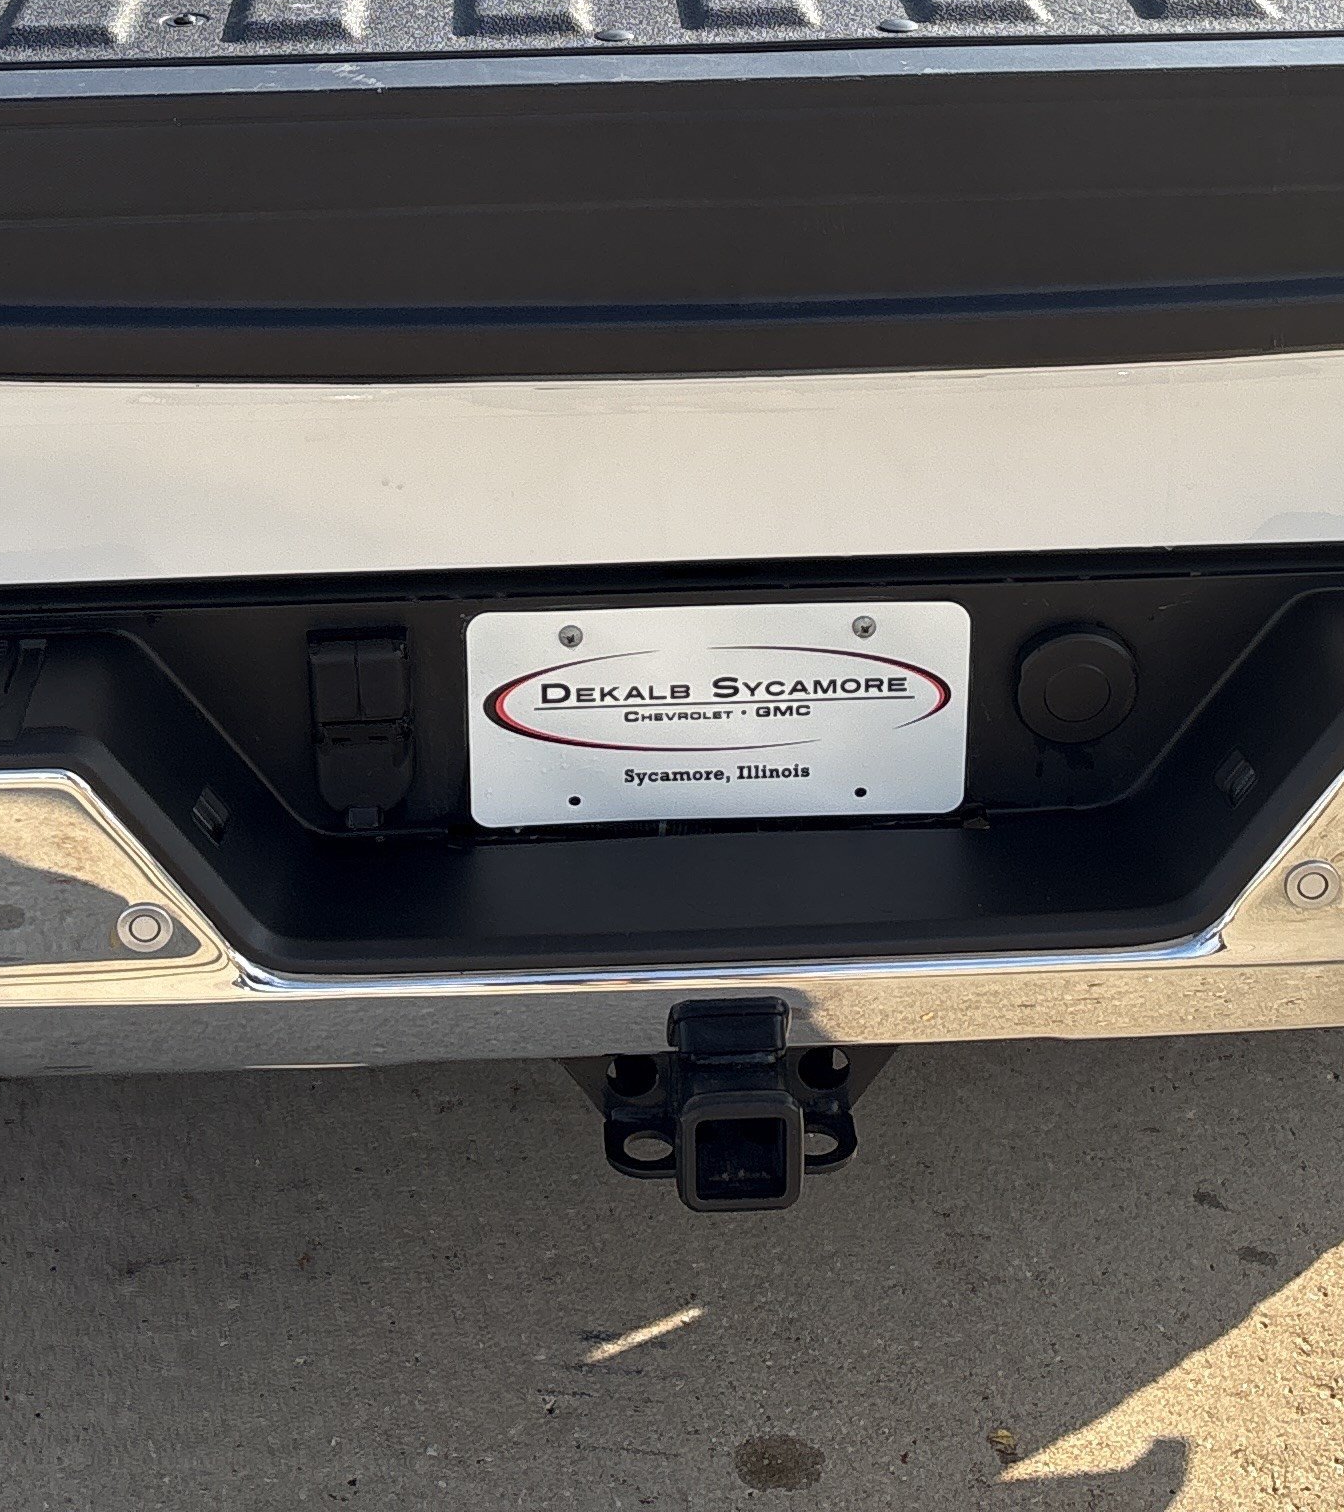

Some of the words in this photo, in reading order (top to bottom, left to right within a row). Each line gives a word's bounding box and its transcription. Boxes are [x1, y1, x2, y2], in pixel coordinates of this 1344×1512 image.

[541, 681, 691, 704] DEKALB
[712, 675, 908, 700] SYCAMORE
[624, 709, 733, 723] CHEVROLET
[755, 704, 811, 718] GMC
[624, 766, 731, 786] Sycamore,
[736, 763, 810, 780] Illinois
